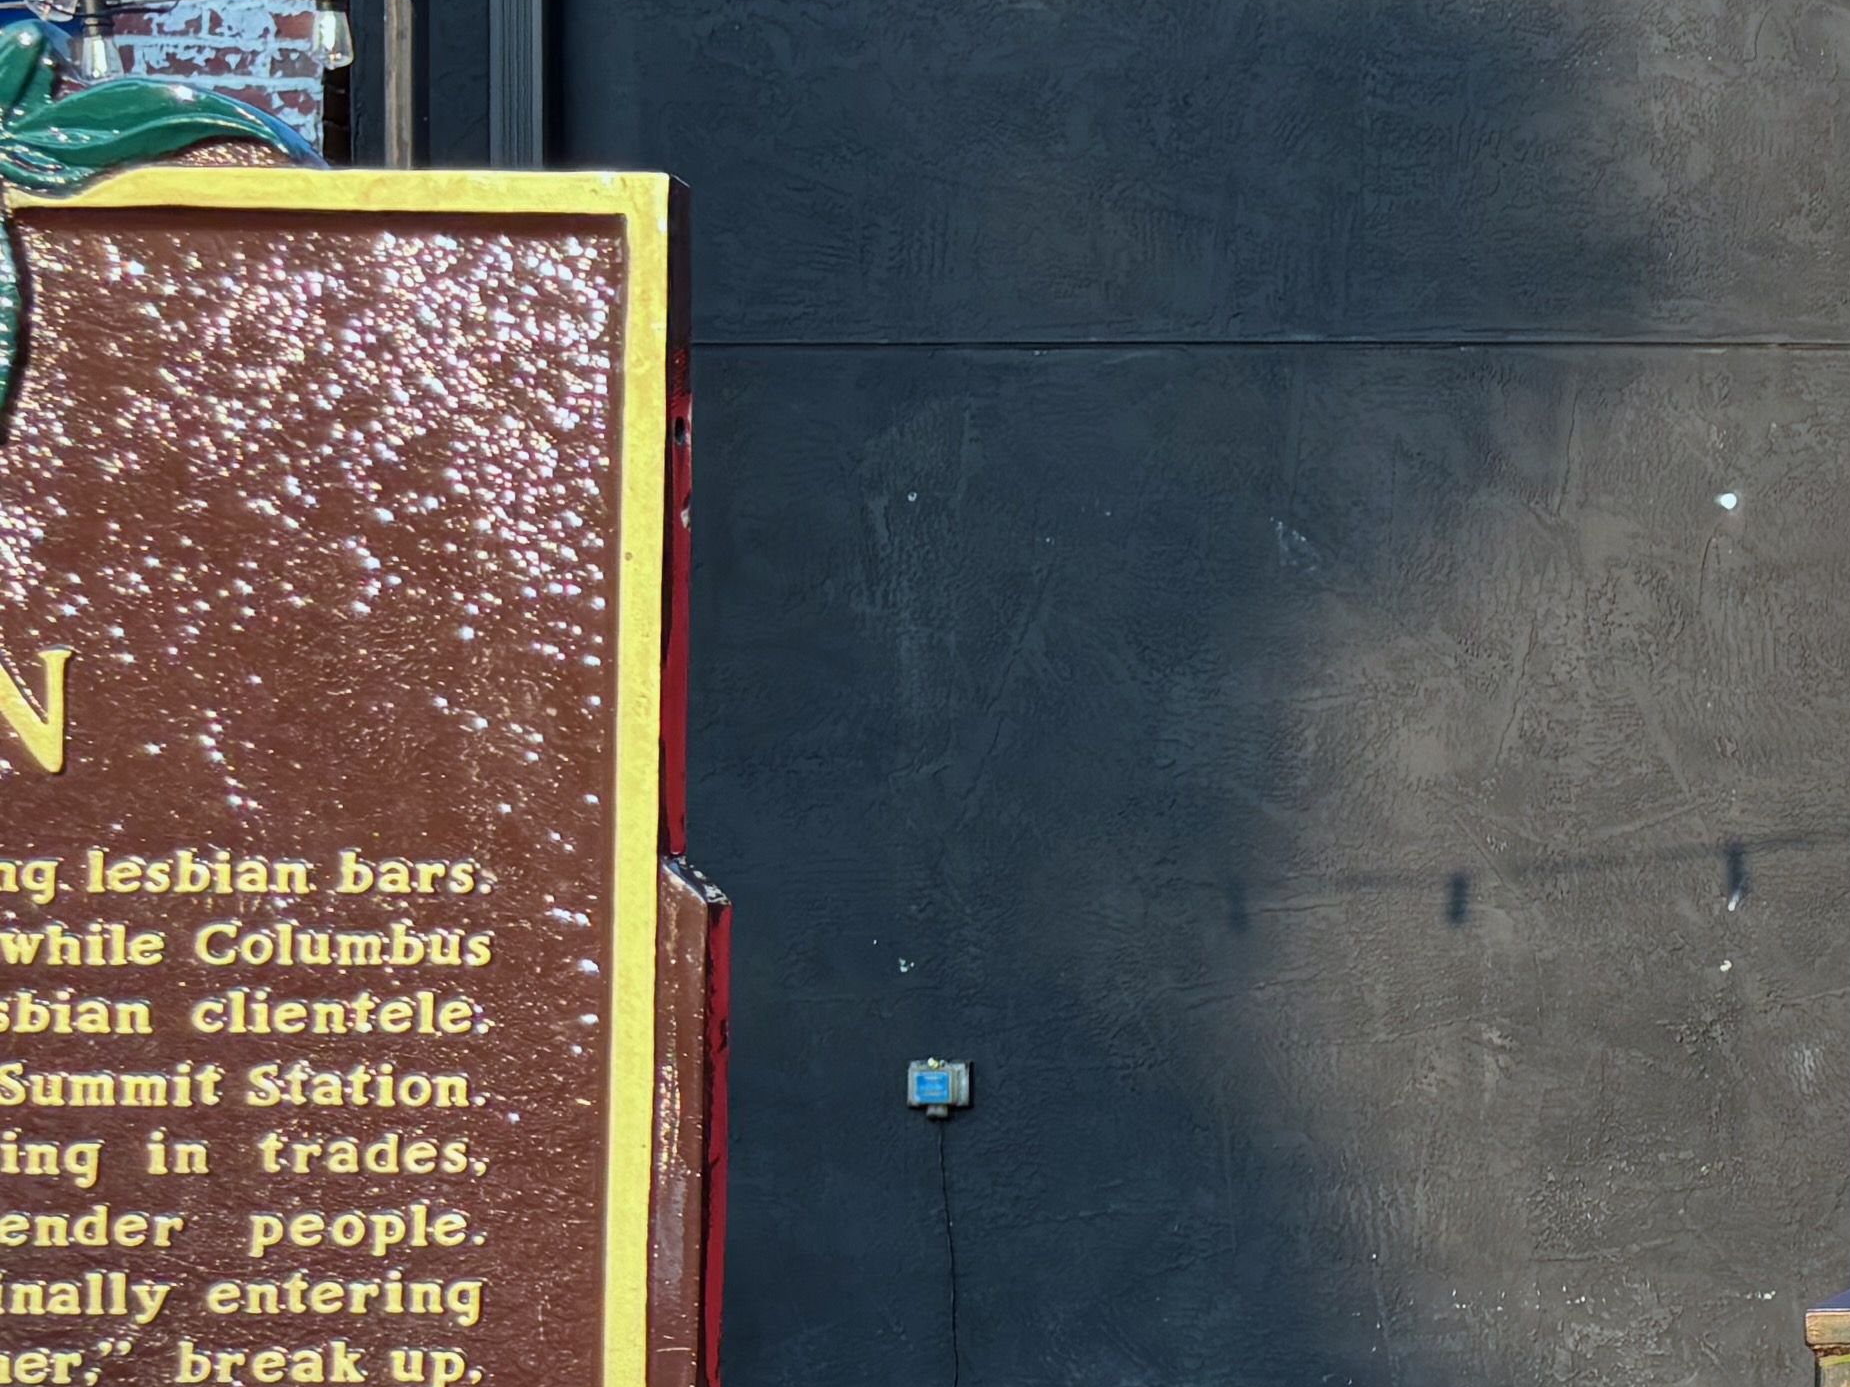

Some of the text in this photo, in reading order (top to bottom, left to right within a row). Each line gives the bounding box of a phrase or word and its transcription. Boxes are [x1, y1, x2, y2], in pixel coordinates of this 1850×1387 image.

[86, 848, 309, 894] lesbian
[337, 850, 493, 894] bars.
[0, 922, 493, 967] while Columbus
[191, 990, 490, 1035] clientele.
[0, 1062, 487, 1107] Summit Station.
[0, 1130, 488, 1188] ing in trades,
[0, 1204, 486, 1257] ender people.
[0, 1269, 483, 1326] nally entering
[176, 1340, 365, 1383] break
